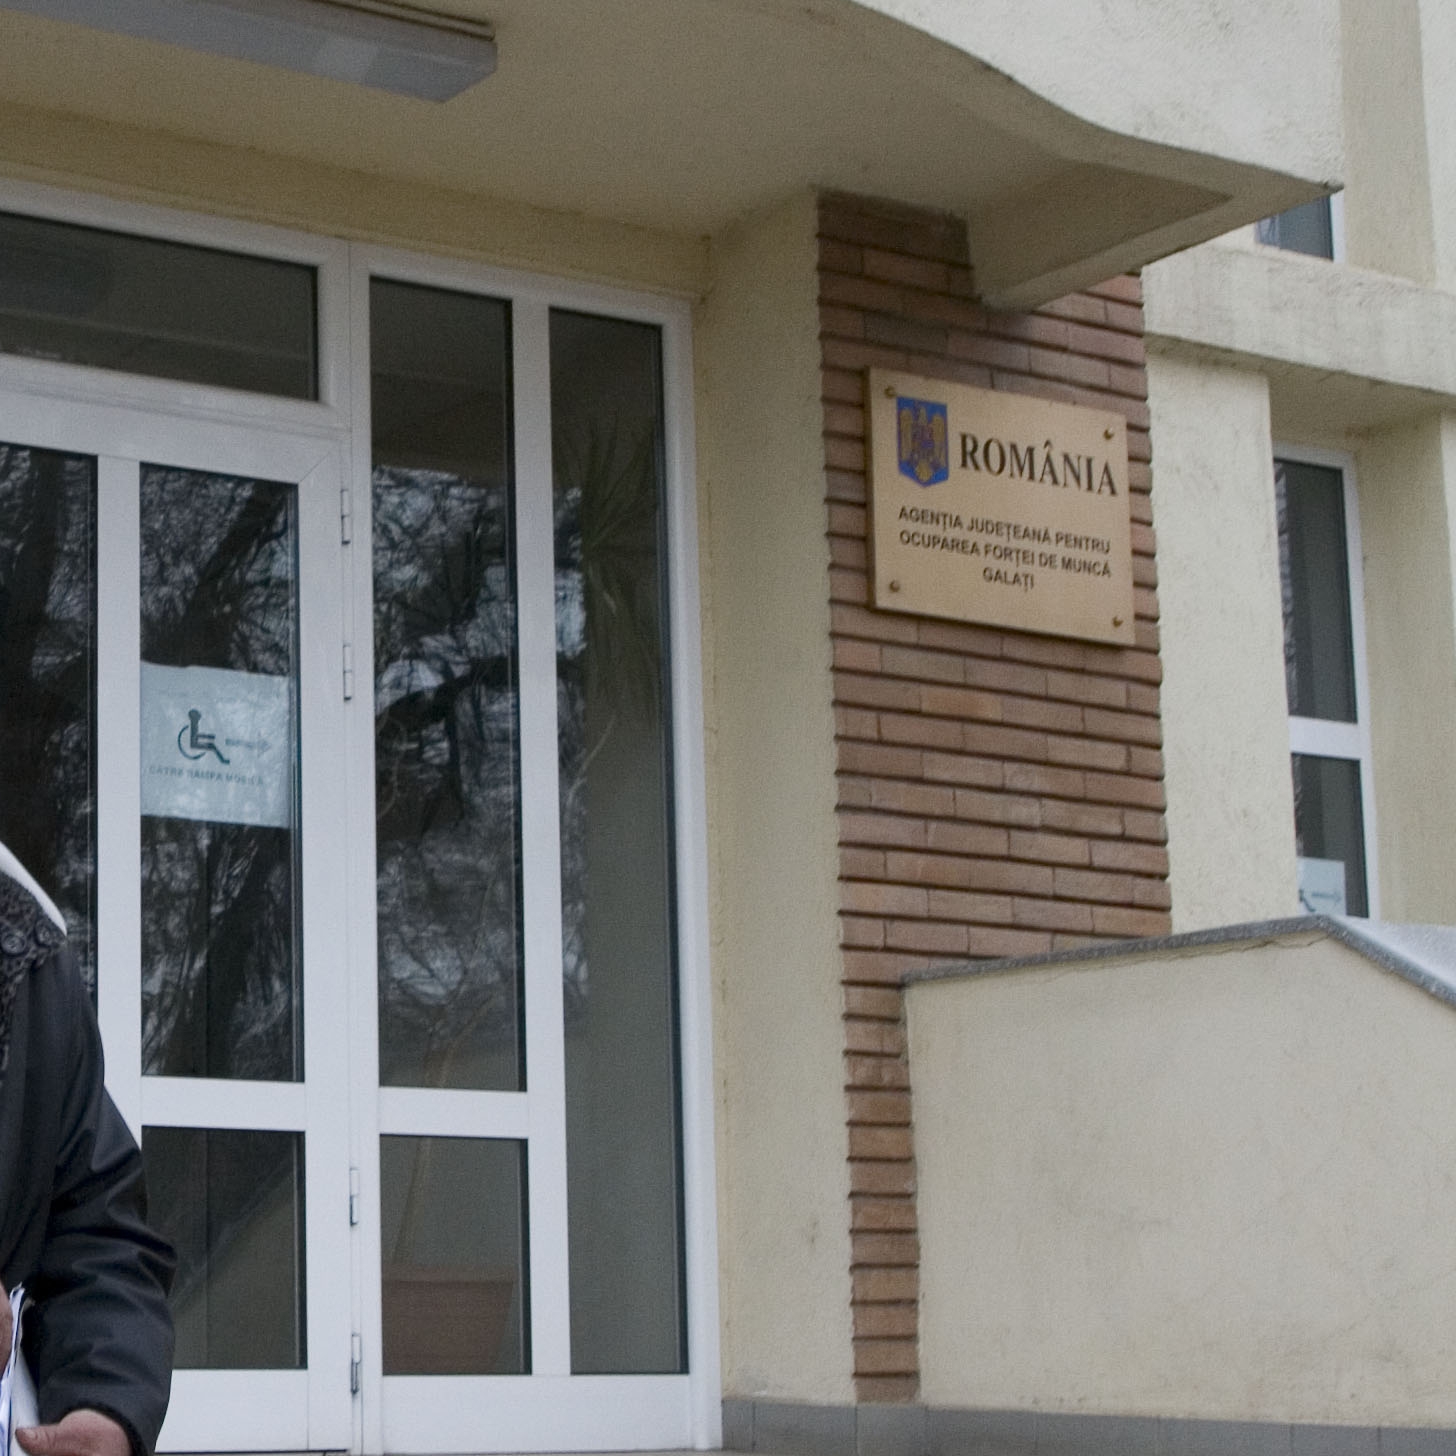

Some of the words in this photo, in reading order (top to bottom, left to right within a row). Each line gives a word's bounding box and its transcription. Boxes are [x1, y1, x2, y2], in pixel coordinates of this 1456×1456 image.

[959, 432, 1118, 496] ROMÂNIA
[899, 529, 980, 557] OCUPAREA
[1039, 552, 1058, 570] DE
[1056, 532, 1111, 555] PENTRU
